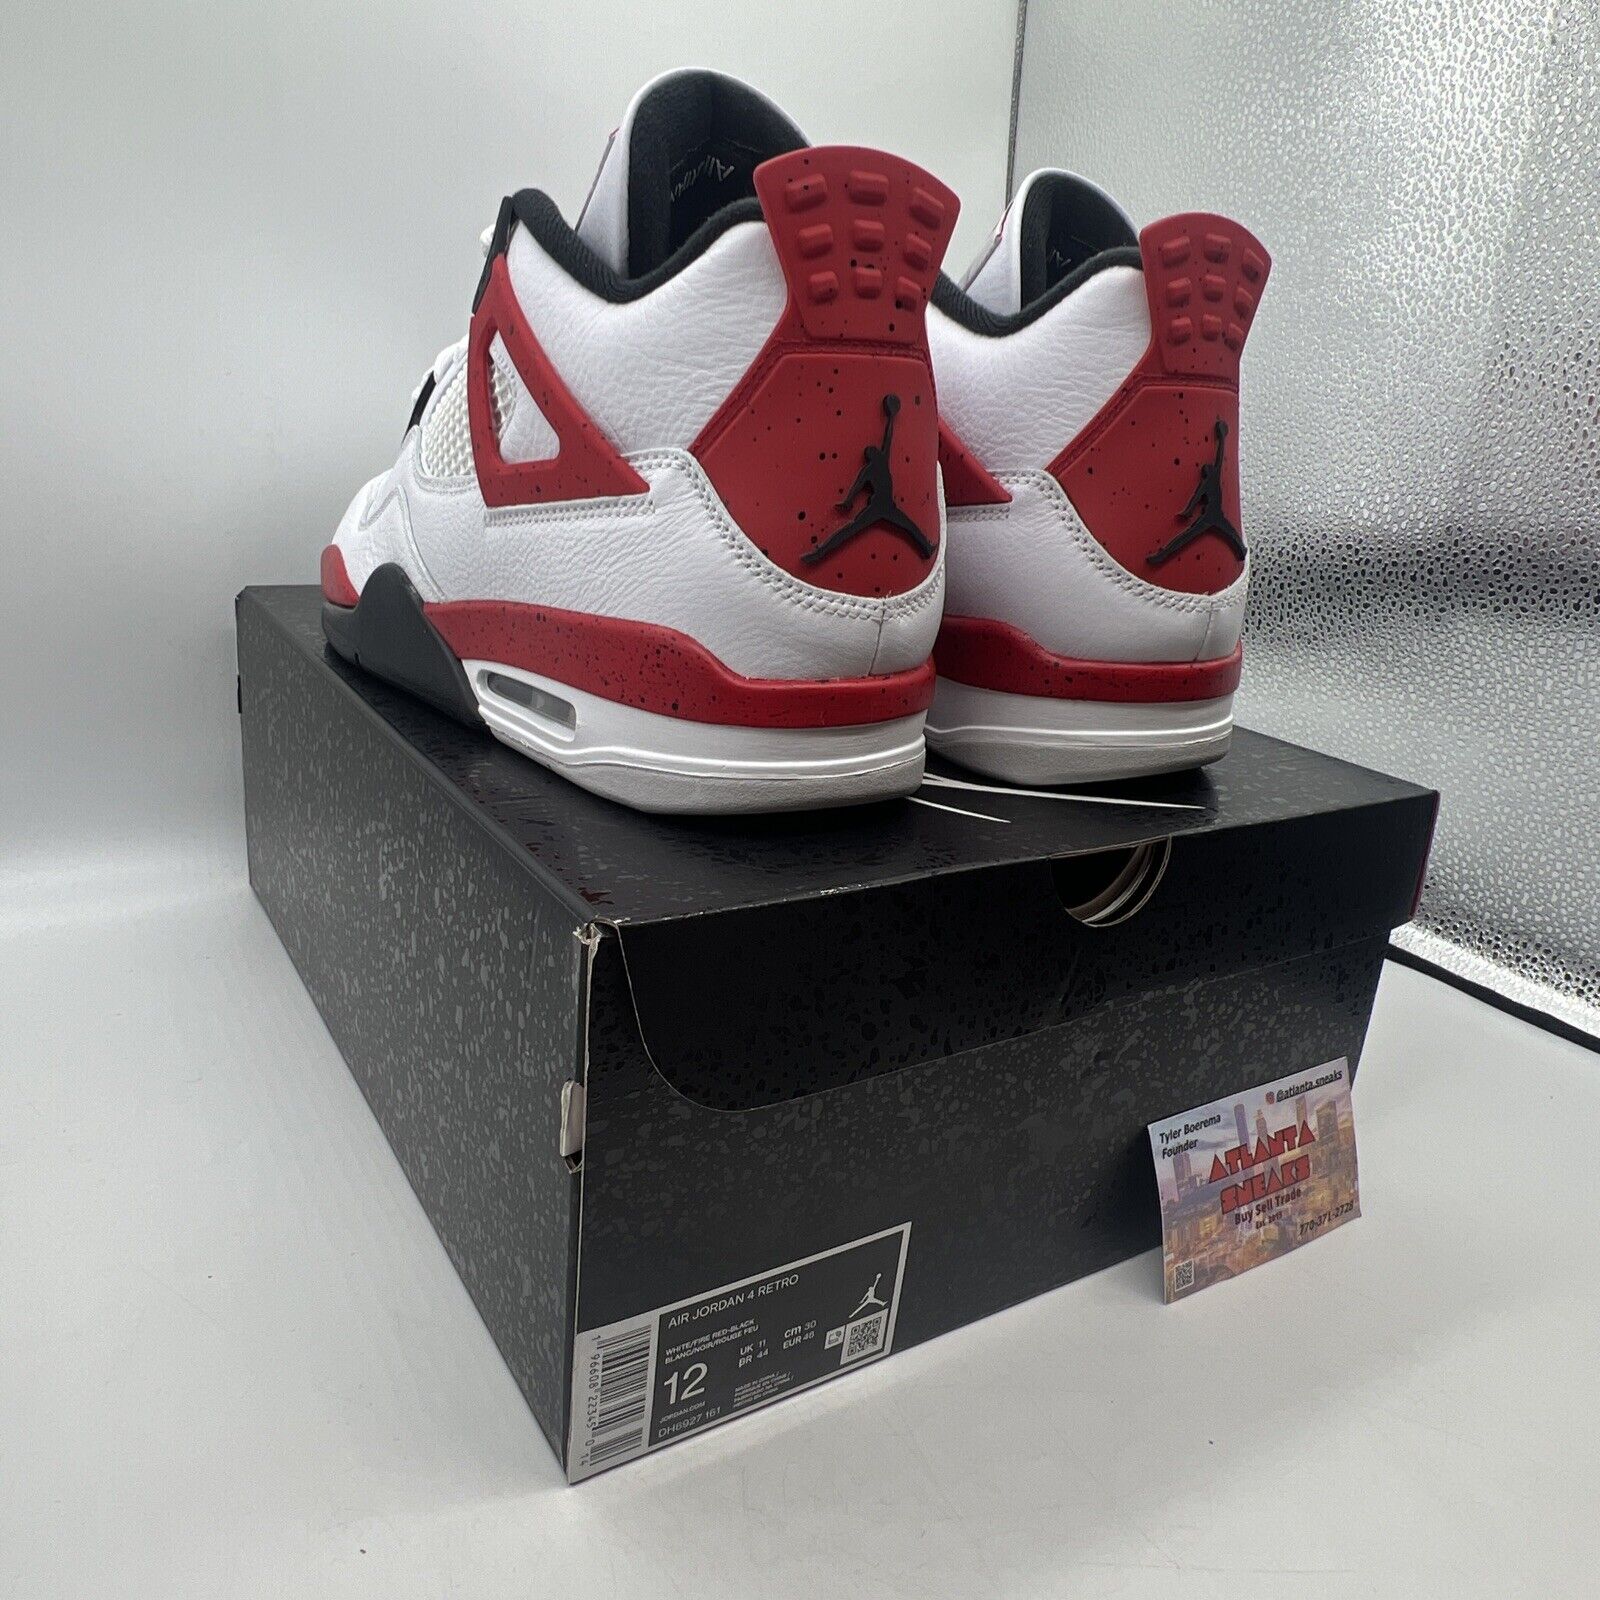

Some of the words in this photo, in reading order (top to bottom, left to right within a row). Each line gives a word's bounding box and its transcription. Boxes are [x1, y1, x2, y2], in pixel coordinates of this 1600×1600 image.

[1276, 1069, 1343, 1102] @atlanta.sneaks
[1159, 1128, 1182, 1145] Tyler
[1183, 1114, 1221, 1134] Boerema
[1162, 1139, 1198, 1159] Founder
[1208, 1120, 1316, 1184] ATLANTA
[1220, 1154, 1312, 1215] SNEAKS
[1234, 1210, 1254, 1225] Buy
[1255, 1198, 1273, 1216] Sell
[1274, 1188, 1301, 1208] Trade
[668, 1312, 690, 1329] AIR
[692, 1293, 745, 1320] JORDAN
[747, 1289, 755, 1300] 4
[757, 1274, 799, 1297] RETRO
[665, 1334, 712, 1356] WHITE/FIRE
[712, 1318, 755, 1339] RED-BLACK
[665, 1330, 742, 1365] BLANC/NOIR/ROUGE
[743, 1324, 759, 1336] FEU
[783, 1335, 802, 1350] EUR
[784, 1325, 802, 1338] cm
[804, 1320, 817, 1331] 30
[738, 1355, 753, 1368] BR
[757, 1348, 769, 1359] 44
[740, 1343, 754, 1355] UK
[759, 1339, 767, 1348] 11
[588, 1353, 601, 1389] 96608
[663, 1362, 708, 1405] 12
[658, 1413, 703, 1438] DH6927
[705, 1406, 721, 1420] 161
[659, 1400, 706, 1424] JORDAN.COM
